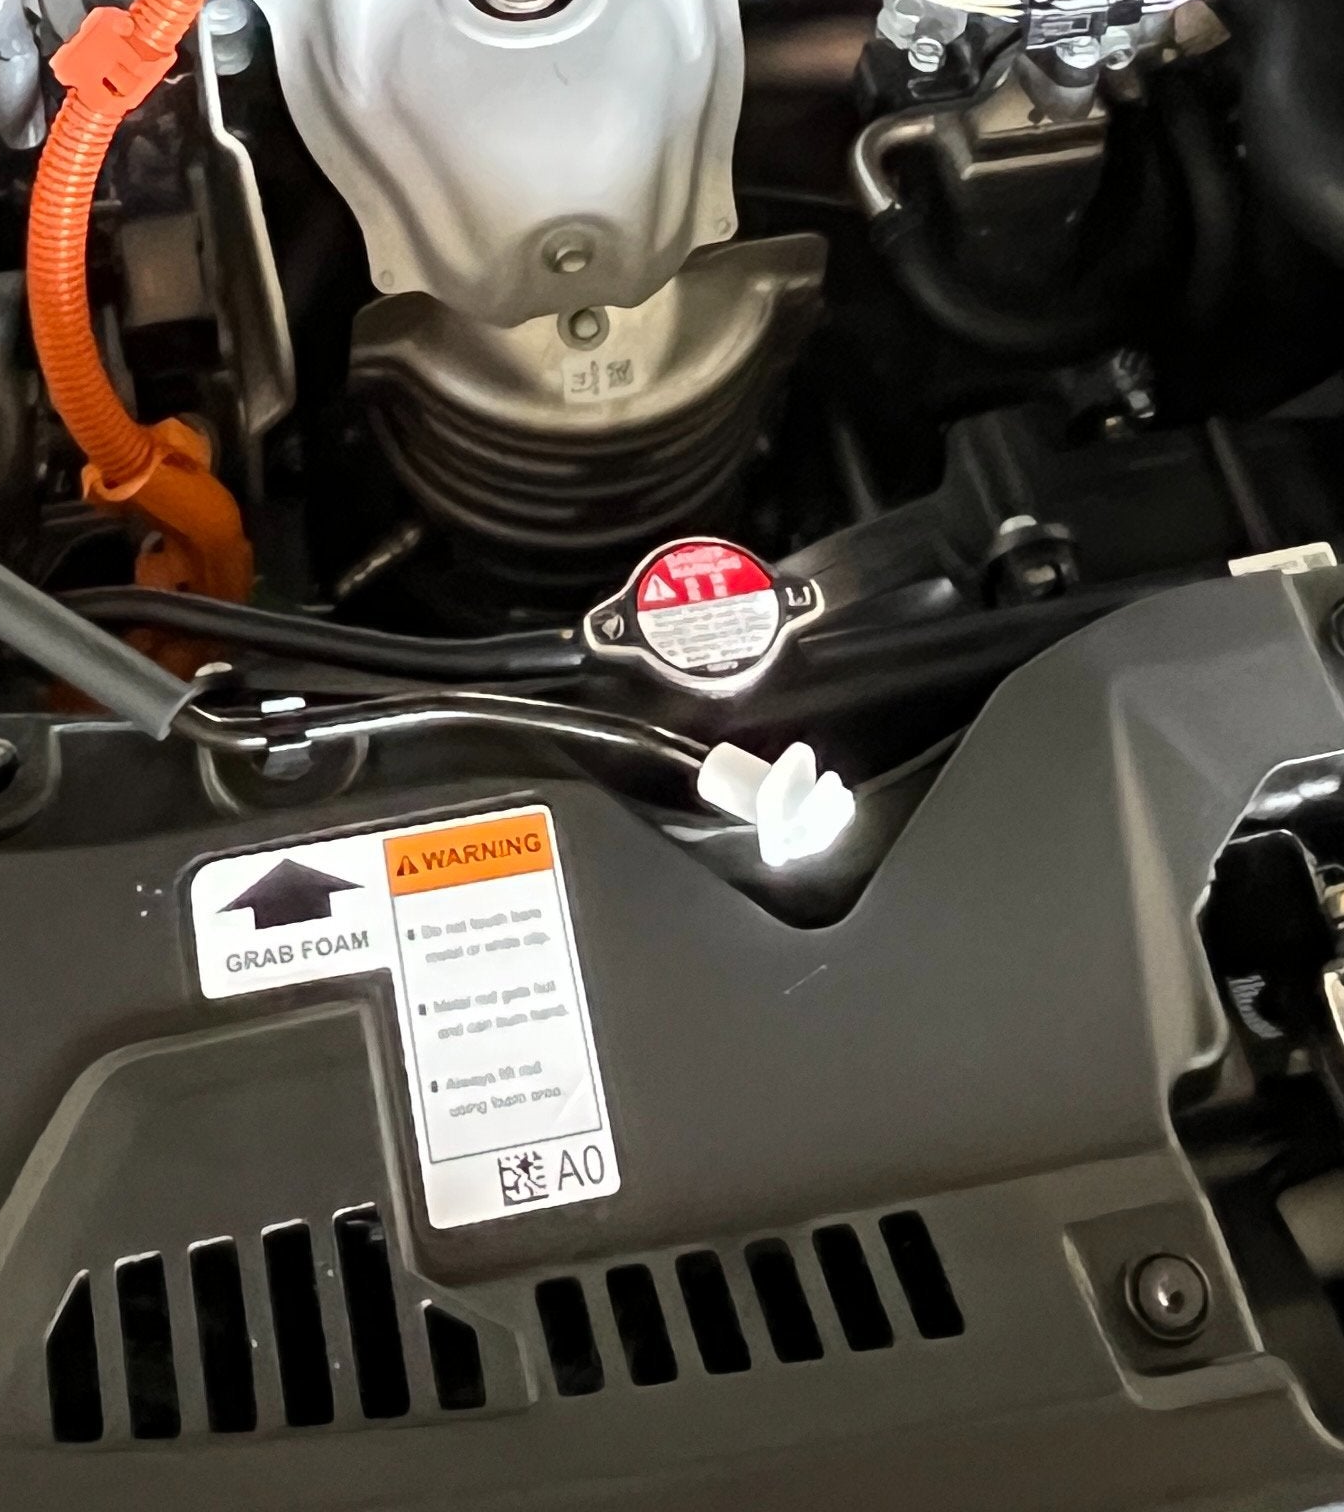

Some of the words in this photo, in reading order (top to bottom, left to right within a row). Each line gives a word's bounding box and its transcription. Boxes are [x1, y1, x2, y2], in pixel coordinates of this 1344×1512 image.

[420, 832, 543, 872] WARNING
[225, 944, 295, 974] GRAB
[301, 929, 370, 960] FOAM
